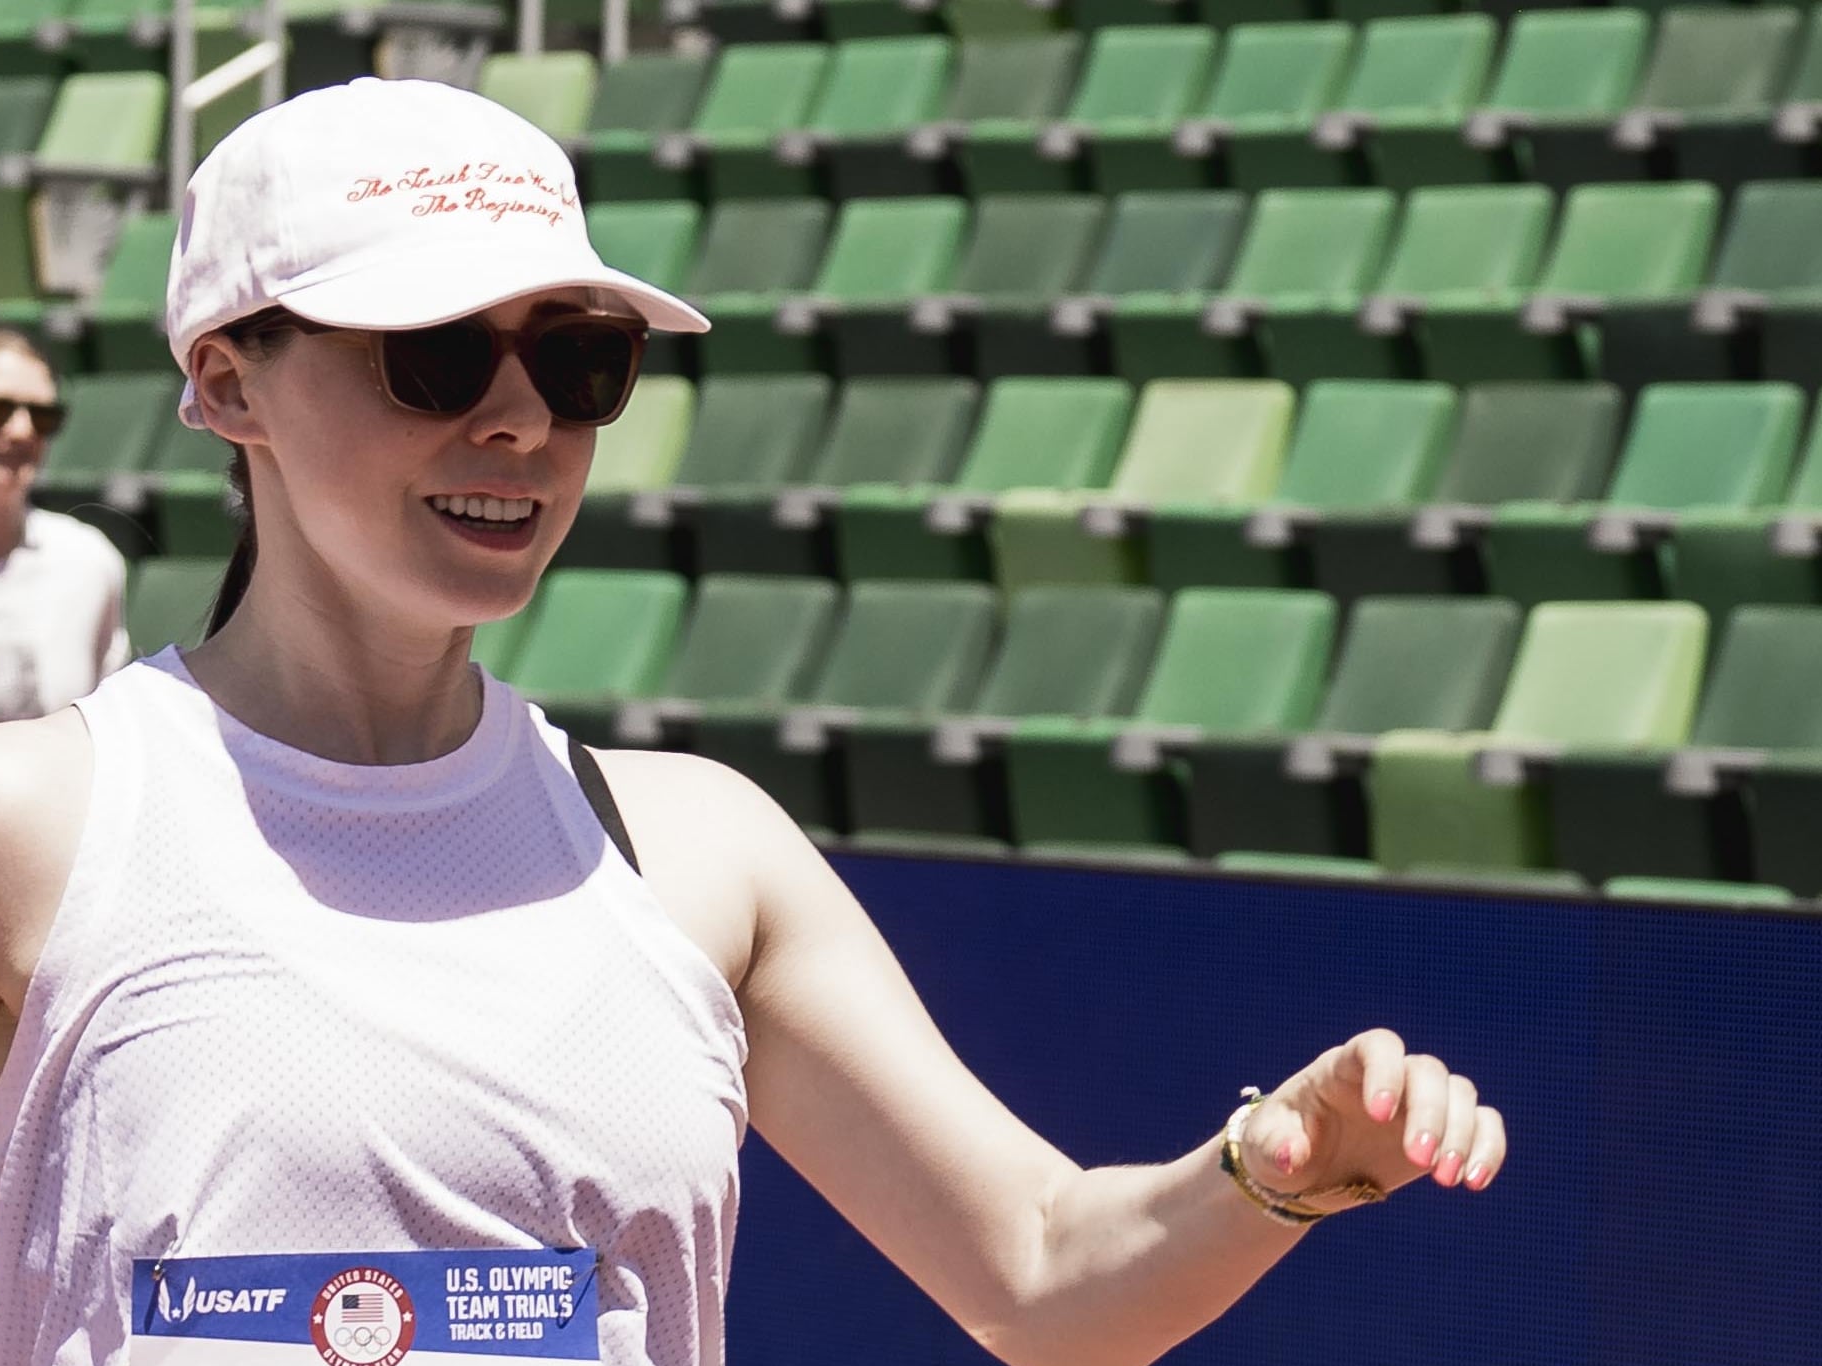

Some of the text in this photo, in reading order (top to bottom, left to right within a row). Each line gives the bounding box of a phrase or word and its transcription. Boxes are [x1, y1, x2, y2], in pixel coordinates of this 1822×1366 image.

[347, 179, 393, 202] The
[397, 163, 471, 190] Finish
[476, 162, 526, 183] Line
[412, 194, 460, 217] The
[464, 187, 564, 228] Beginning
[321, 1269, 404, 1301] UNITED STATES
[446, 1265, 574, 1293] U.S. OLYMPIC
[195, 1288, 287, 1314] USATF
[445, 1293, 574, 1321] TEAM TRIALS
[449, 1321, 544, 1341] TRACK & FIELD
